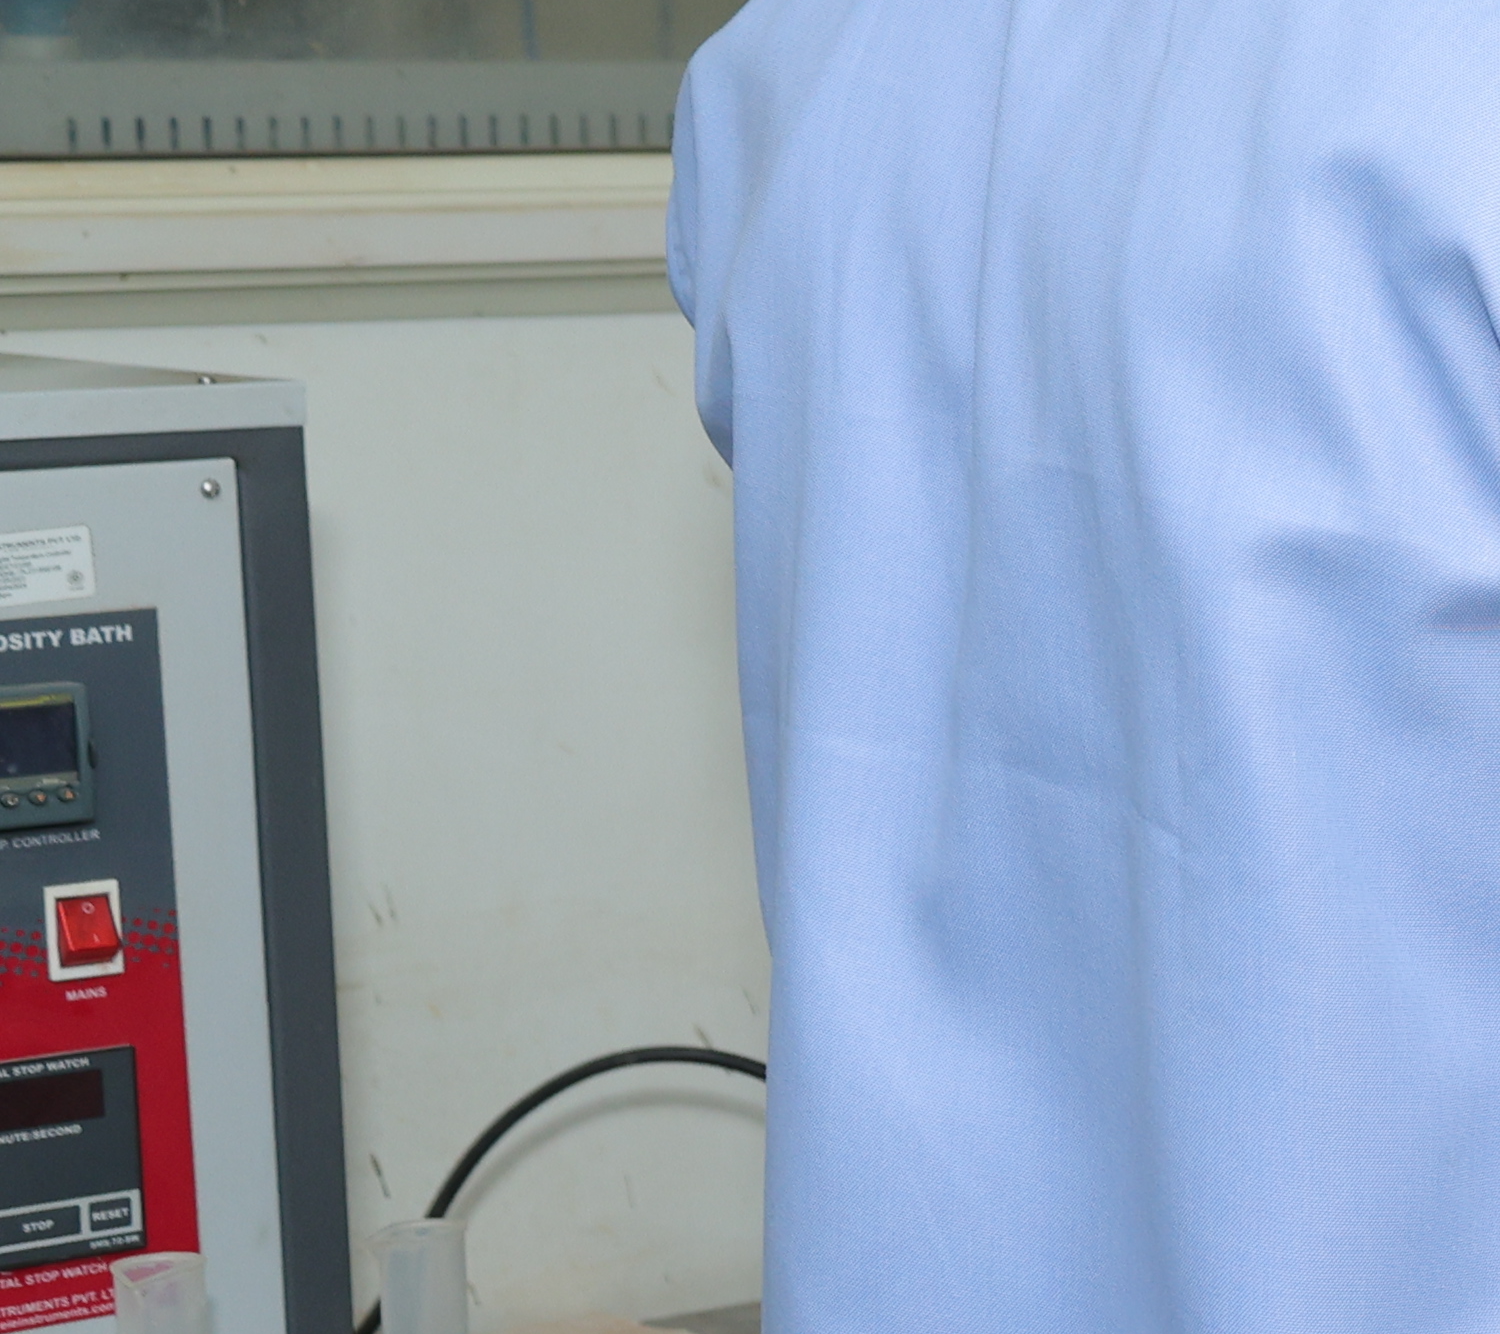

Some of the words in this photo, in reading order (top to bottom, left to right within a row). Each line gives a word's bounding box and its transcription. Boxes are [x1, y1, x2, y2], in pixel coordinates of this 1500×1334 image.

[69, 623, 133, 647] BATH
[11, 828, 101, 849] CONTROLLER
[65, 986, 108, 1002] MAINS
[12, 1062, 46, 1077] STOP
[45, 1056, 90, 1072] WATCH
[91, 1207, 130, 1222] RESET
[22, 1219, 54, 1234] STOP
[24, 1269, 61, 1286] STOP
